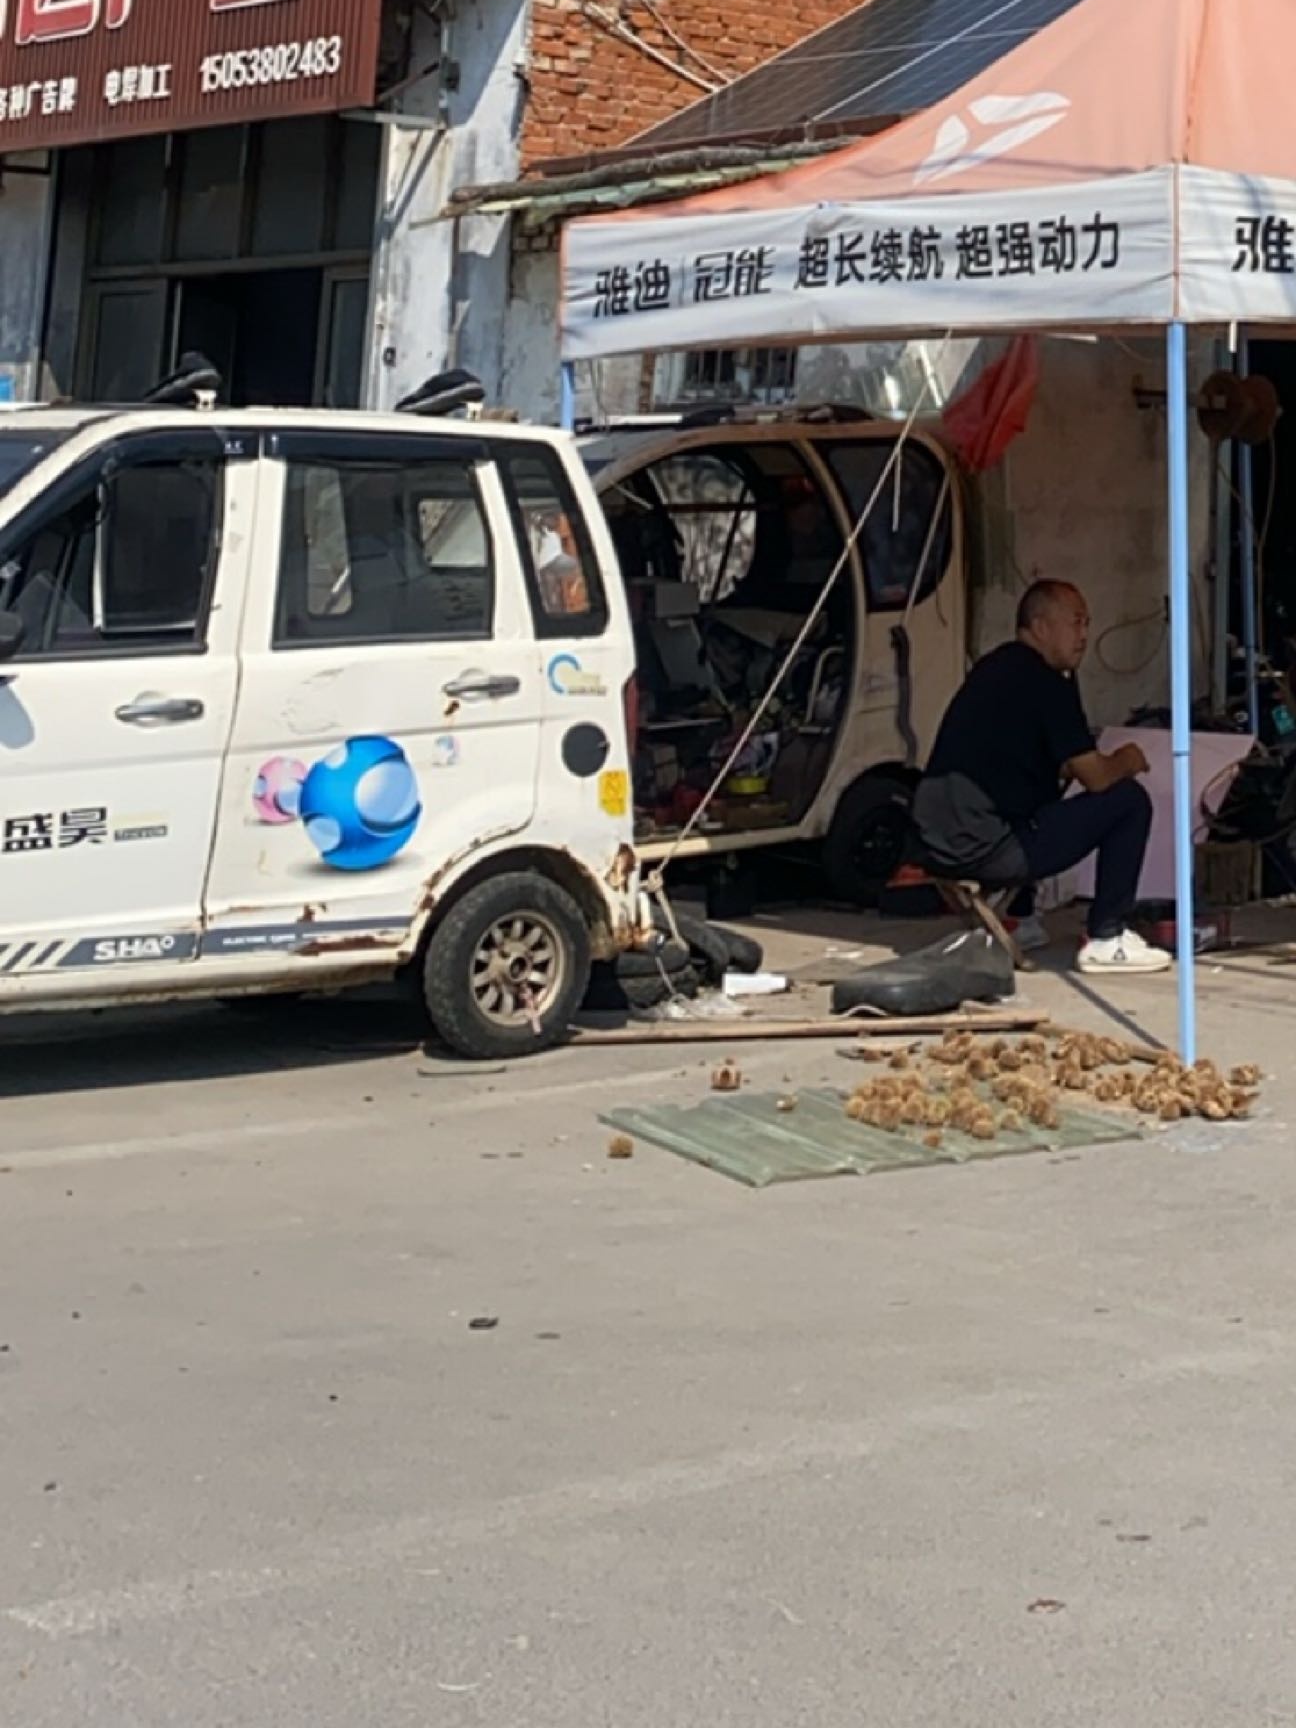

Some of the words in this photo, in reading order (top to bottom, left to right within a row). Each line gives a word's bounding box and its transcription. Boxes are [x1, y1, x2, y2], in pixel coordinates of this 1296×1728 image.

[200, 35, 342, 93] 15053802483
[593, 258, 671, 318] 雅迪
[693, 245, 776, 304] 冠能
[794, 225, 943, 291] 超长续航
[955, 212, 1120, 279] 超强动力
